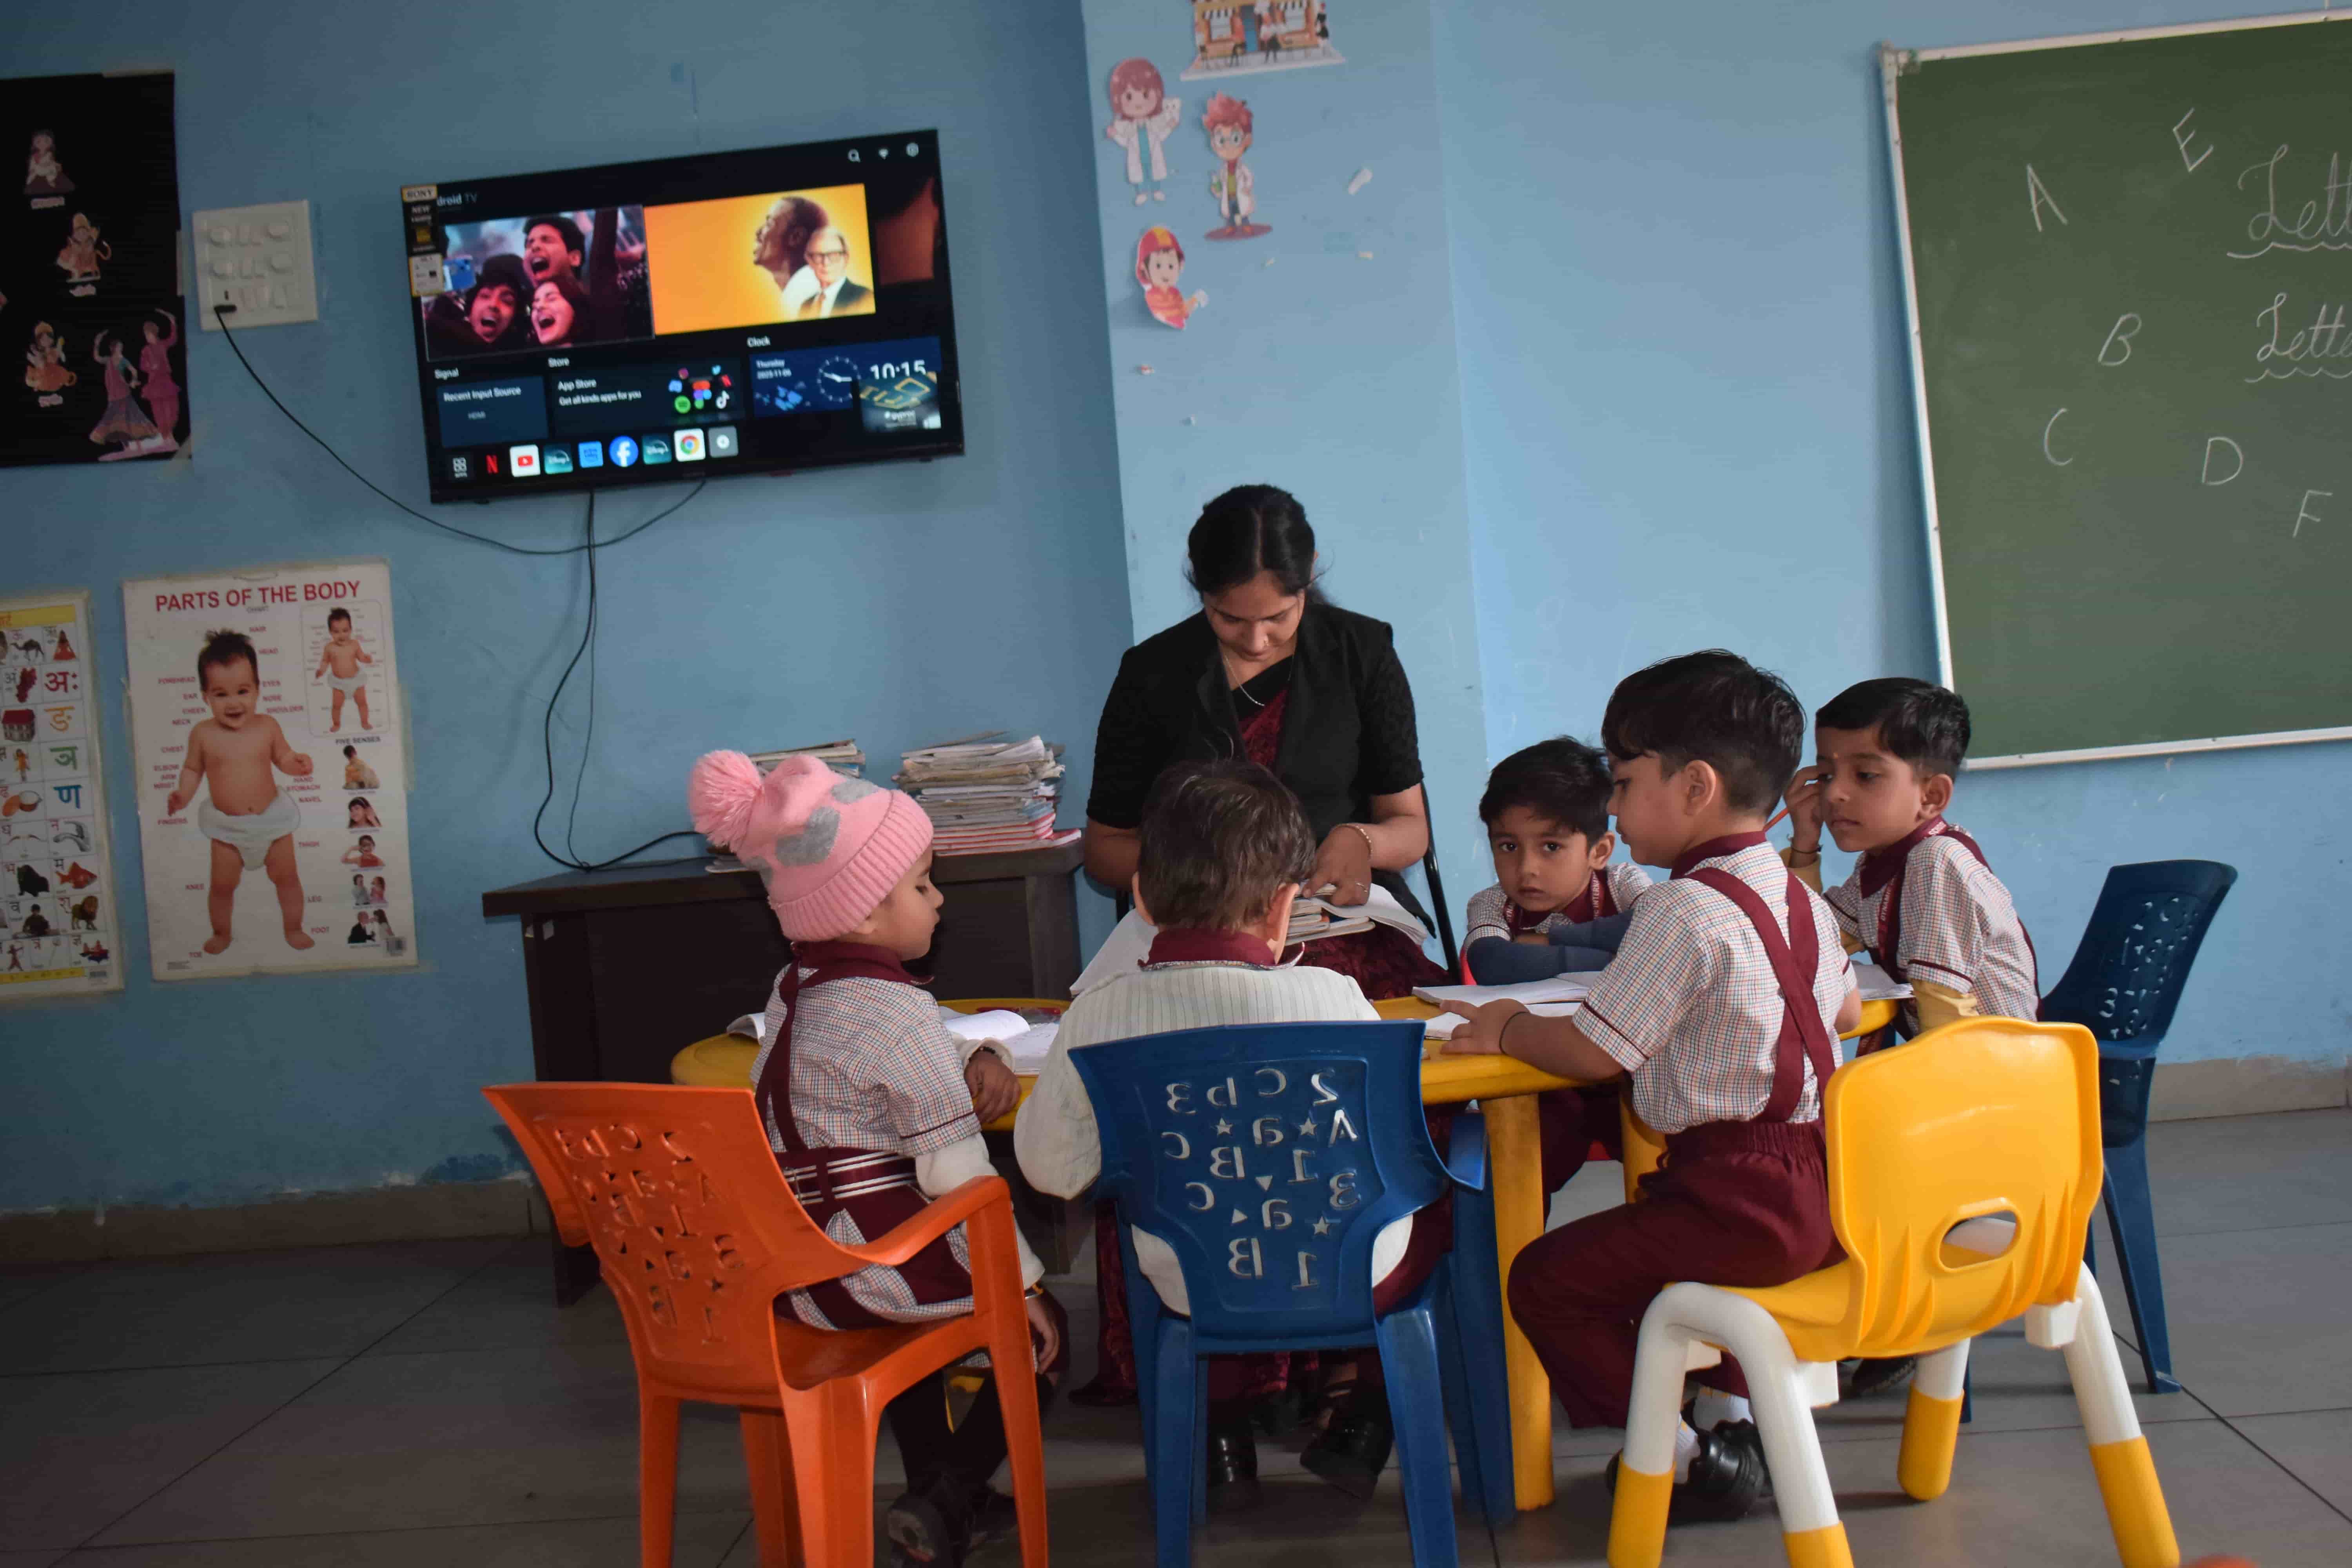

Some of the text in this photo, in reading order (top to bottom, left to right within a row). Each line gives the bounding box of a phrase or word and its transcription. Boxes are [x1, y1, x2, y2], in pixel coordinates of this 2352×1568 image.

[2172, 108, 2213, 172] E
[437, 194, 462, 206] droid
[2026, 163, 2068, 232] A
[747, 336, 771, 347] Clock
[2098, 313, 2141, 366] B
[434, 368, 459, 380] Signal
[548, 357, 570, 368] Store
[443, 387, 521, 401] Recent Input Source
[558, 379, 597, 392] App Store
[559, 396, 572, 406] Get
[581, 394, 600, 403] kinds
[600, 393, 617, 403] apps
[617, 390, 627, 400] for
[627, 390, 642, 401] you
[2043, 407, 2073, 466] C
[2201, 436, 2243, 485] D
[2292, 490, 2333, 537] F
[155, 581, 360, 612] PARTS OF THE BODY
[44, 671, 78, 693] अः
[53, 784, 82, 809] ण
